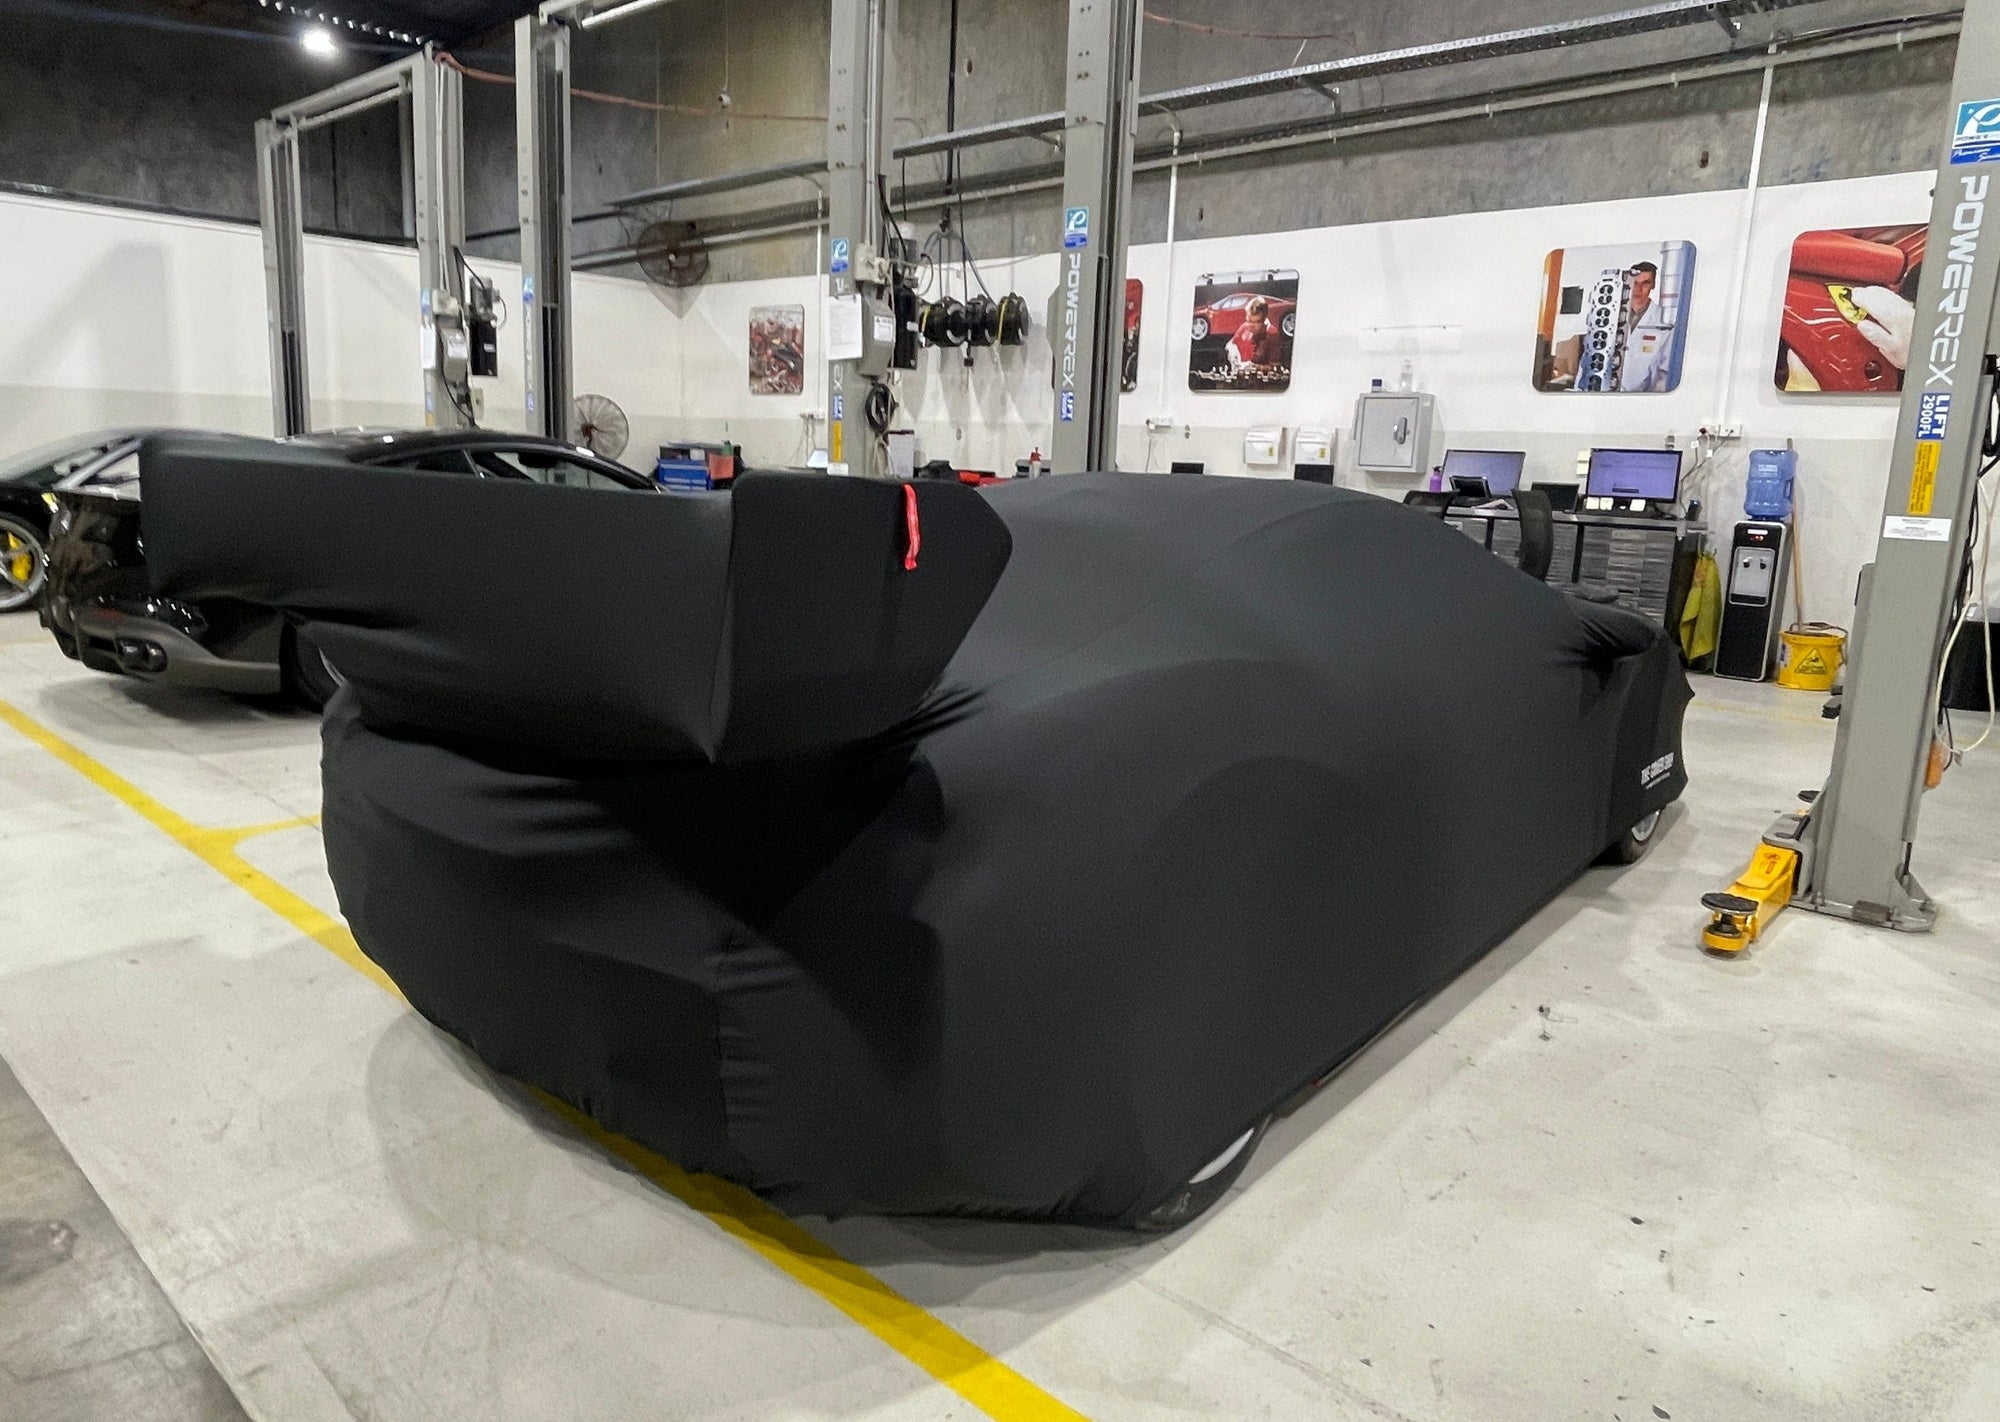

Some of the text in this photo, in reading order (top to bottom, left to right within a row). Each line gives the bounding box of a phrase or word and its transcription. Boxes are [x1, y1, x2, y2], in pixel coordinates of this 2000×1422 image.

[1061, 252, 1081, 387] POWERREX
[1925, 175, 1990, 386] POWERREX
[1917, 394, 1936, 438] 2900FL
[1931, 394, 1951, 438] LIFT
